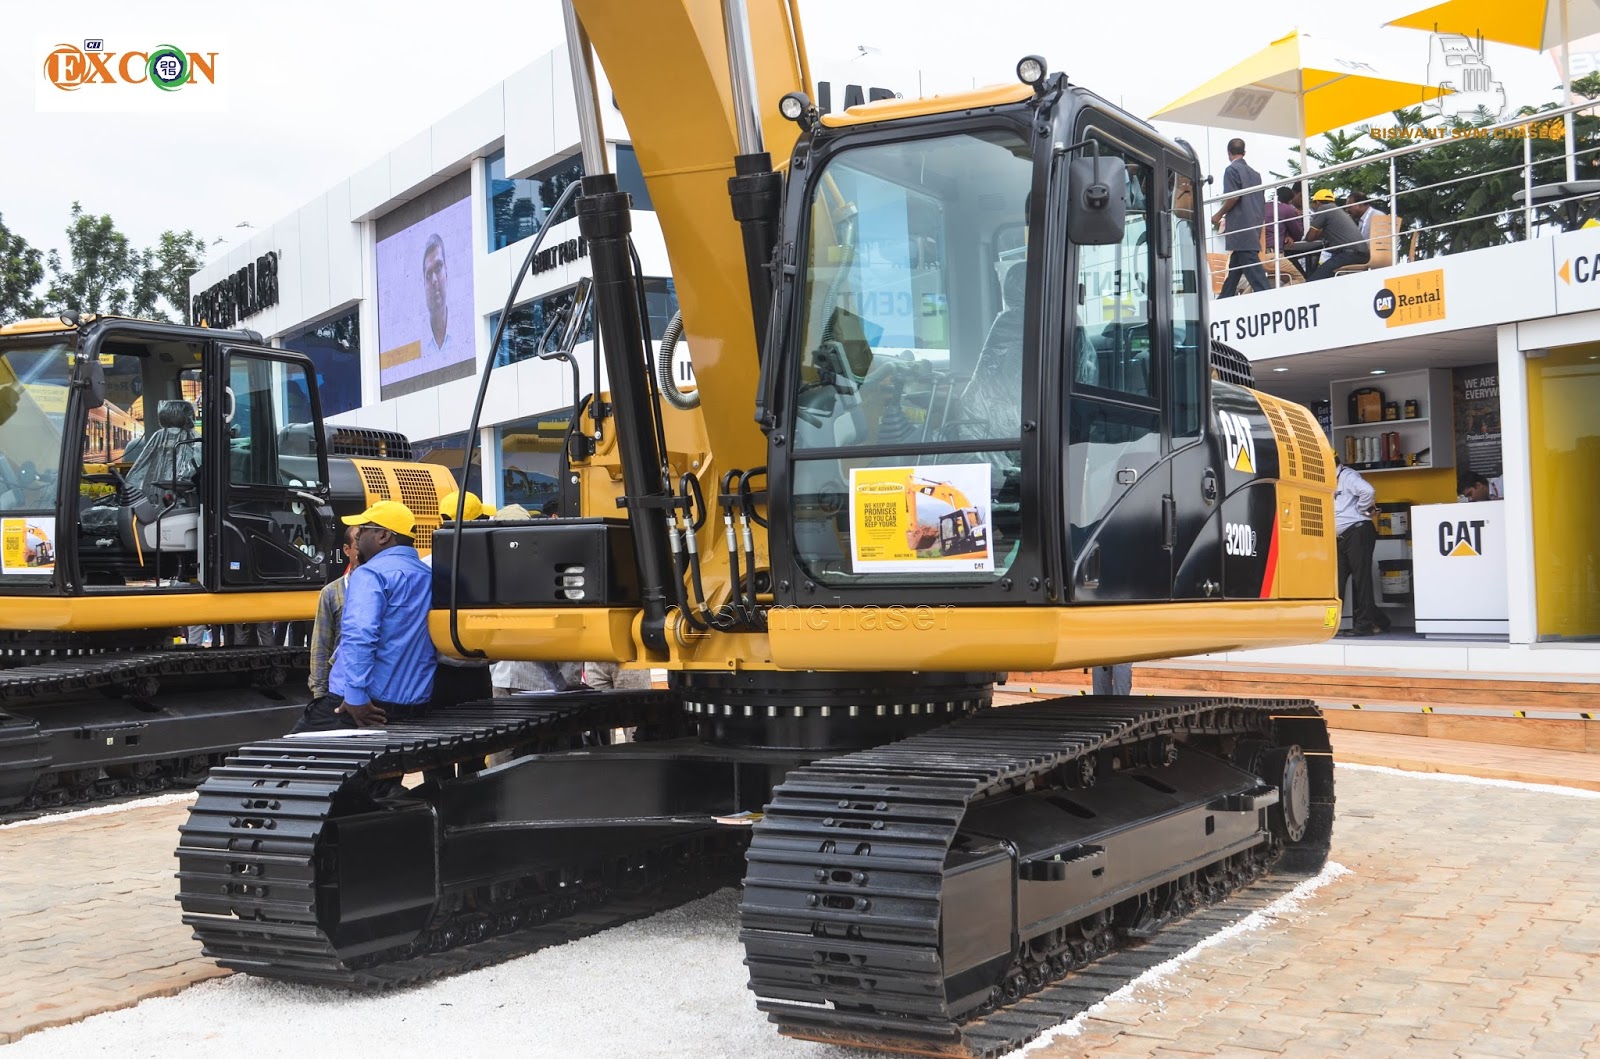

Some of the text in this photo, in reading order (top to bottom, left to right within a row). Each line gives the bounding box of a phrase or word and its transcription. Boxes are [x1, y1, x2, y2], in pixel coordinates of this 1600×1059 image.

[558, 239, 578, 265] FOR
[1376, 288, 1441, 312] CAT Rental
[1235, 303, 1321, 340] SUPPORT
[1464, 376, 1496, 389] WE ARE
[1219, 409, 1257, 474] CAT
[864, 507, 897, 516] PROMISES
[1438, 519, 1486, 557] CAT
